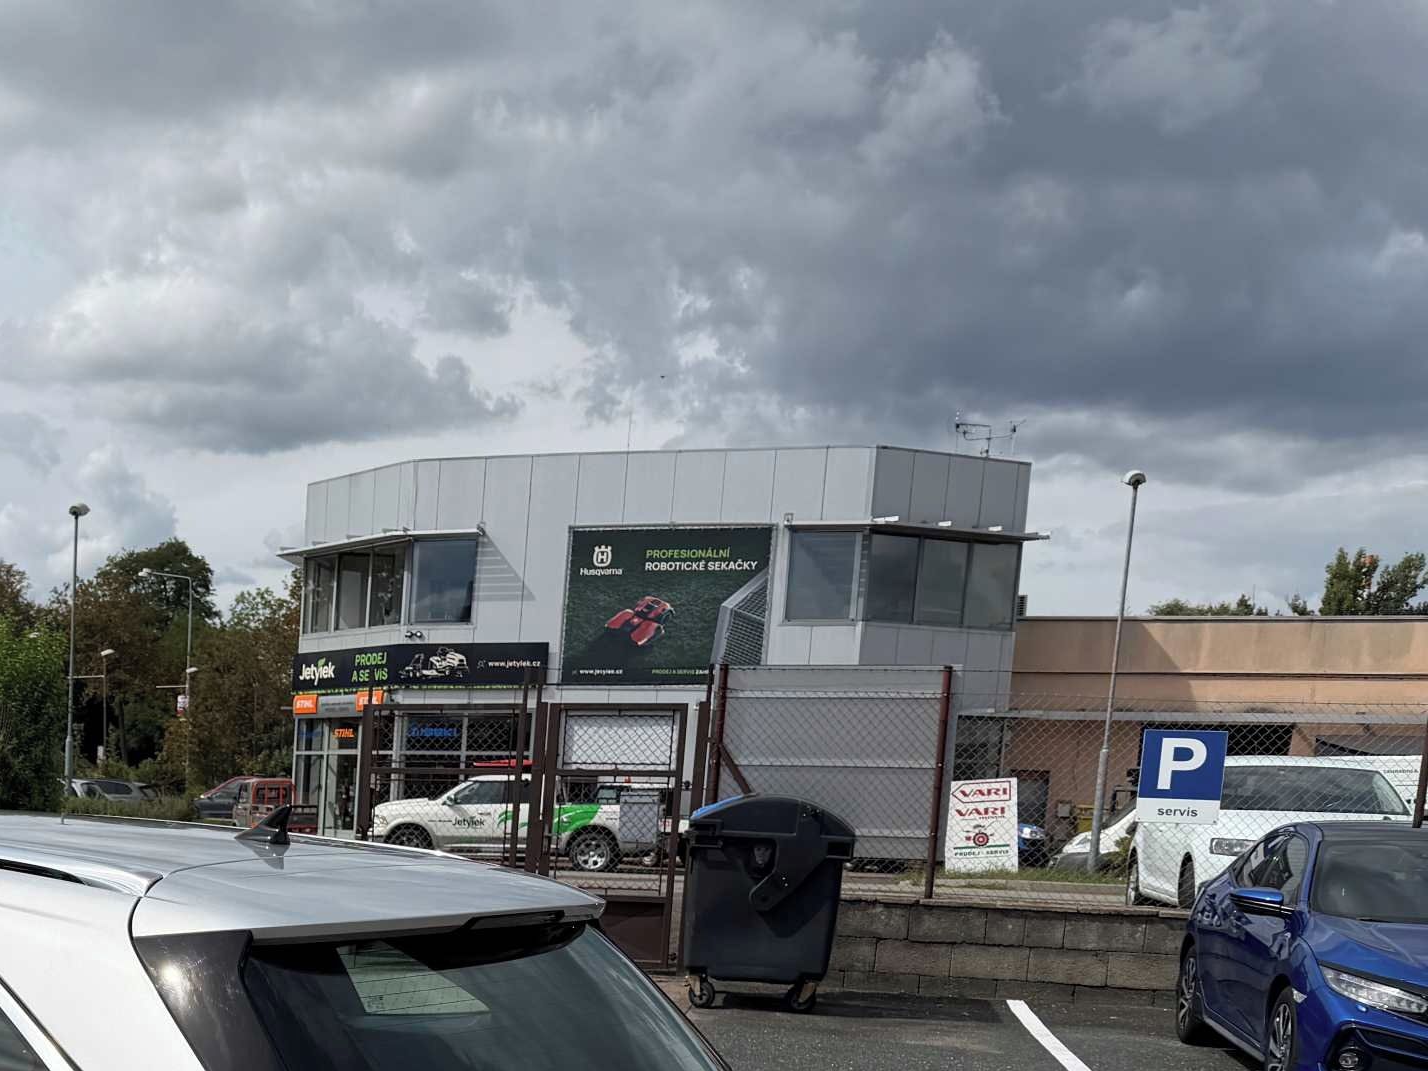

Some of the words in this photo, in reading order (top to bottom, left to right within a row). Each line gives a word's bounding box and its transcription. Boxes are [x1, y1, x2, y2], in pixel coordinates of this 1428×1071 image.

[645, 547, 730, 559] PROFESIONÁLNÍ
[644, 560, 705, 571] ROBOTICKÉ
[707, 559, 758, 571] SEKAČKY
[579, 567, 623, 577] Husqvarna
[355, 651, 387, 666] PRODEJ
[358, 667, 388, 682] SEVIS
[332, 729, 355, 739] STIHL
[1156, 737, 1208, 790] P
[959, 787, 1008, 797] VARI
[955, 806, 1006, 817] VARI
[1157, 807, 1198, 817] servis
